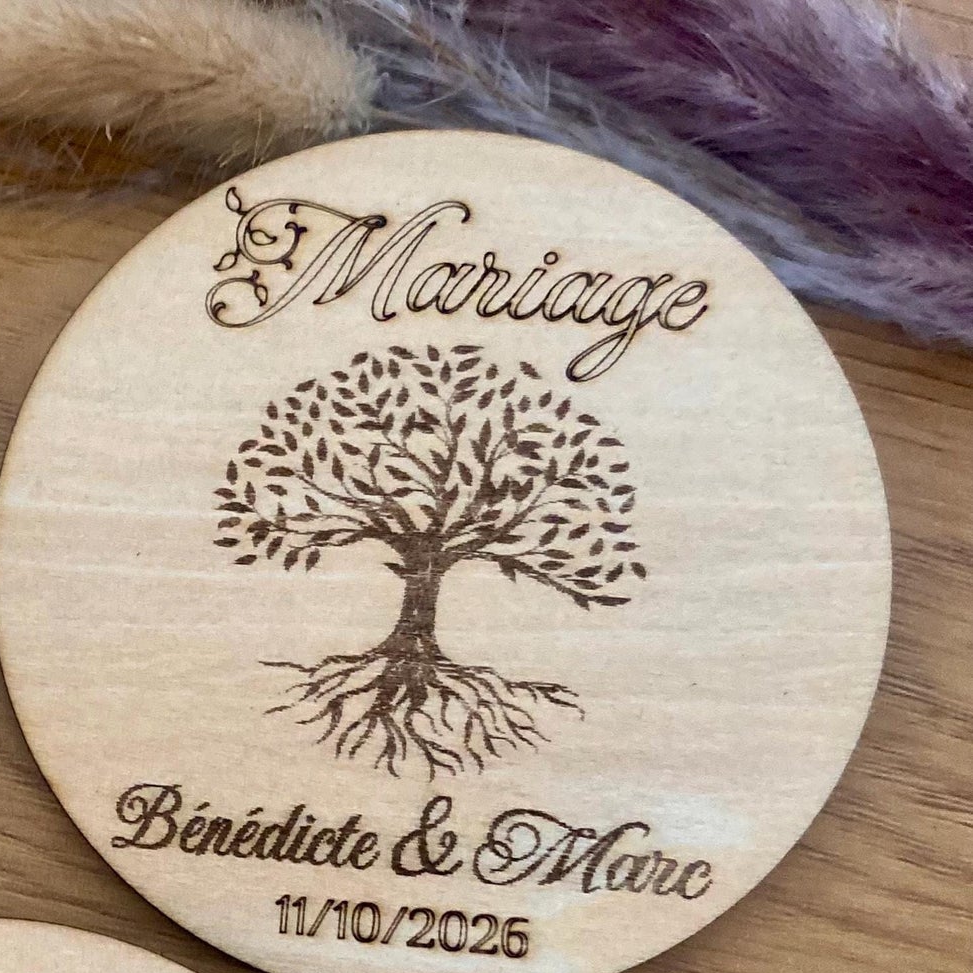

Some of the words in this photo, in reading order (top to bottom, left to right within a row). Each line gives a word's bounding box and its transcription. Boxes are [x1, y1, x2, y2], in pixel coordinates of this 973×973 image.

[205, 186, 708, 382] Mariage
[112, 782, 382, 872] Bénédicte
[391, 795, 464, 877] &
[471, 807, 715, 901] Marc
[274, 894, 531, 959] 11/10/2026
